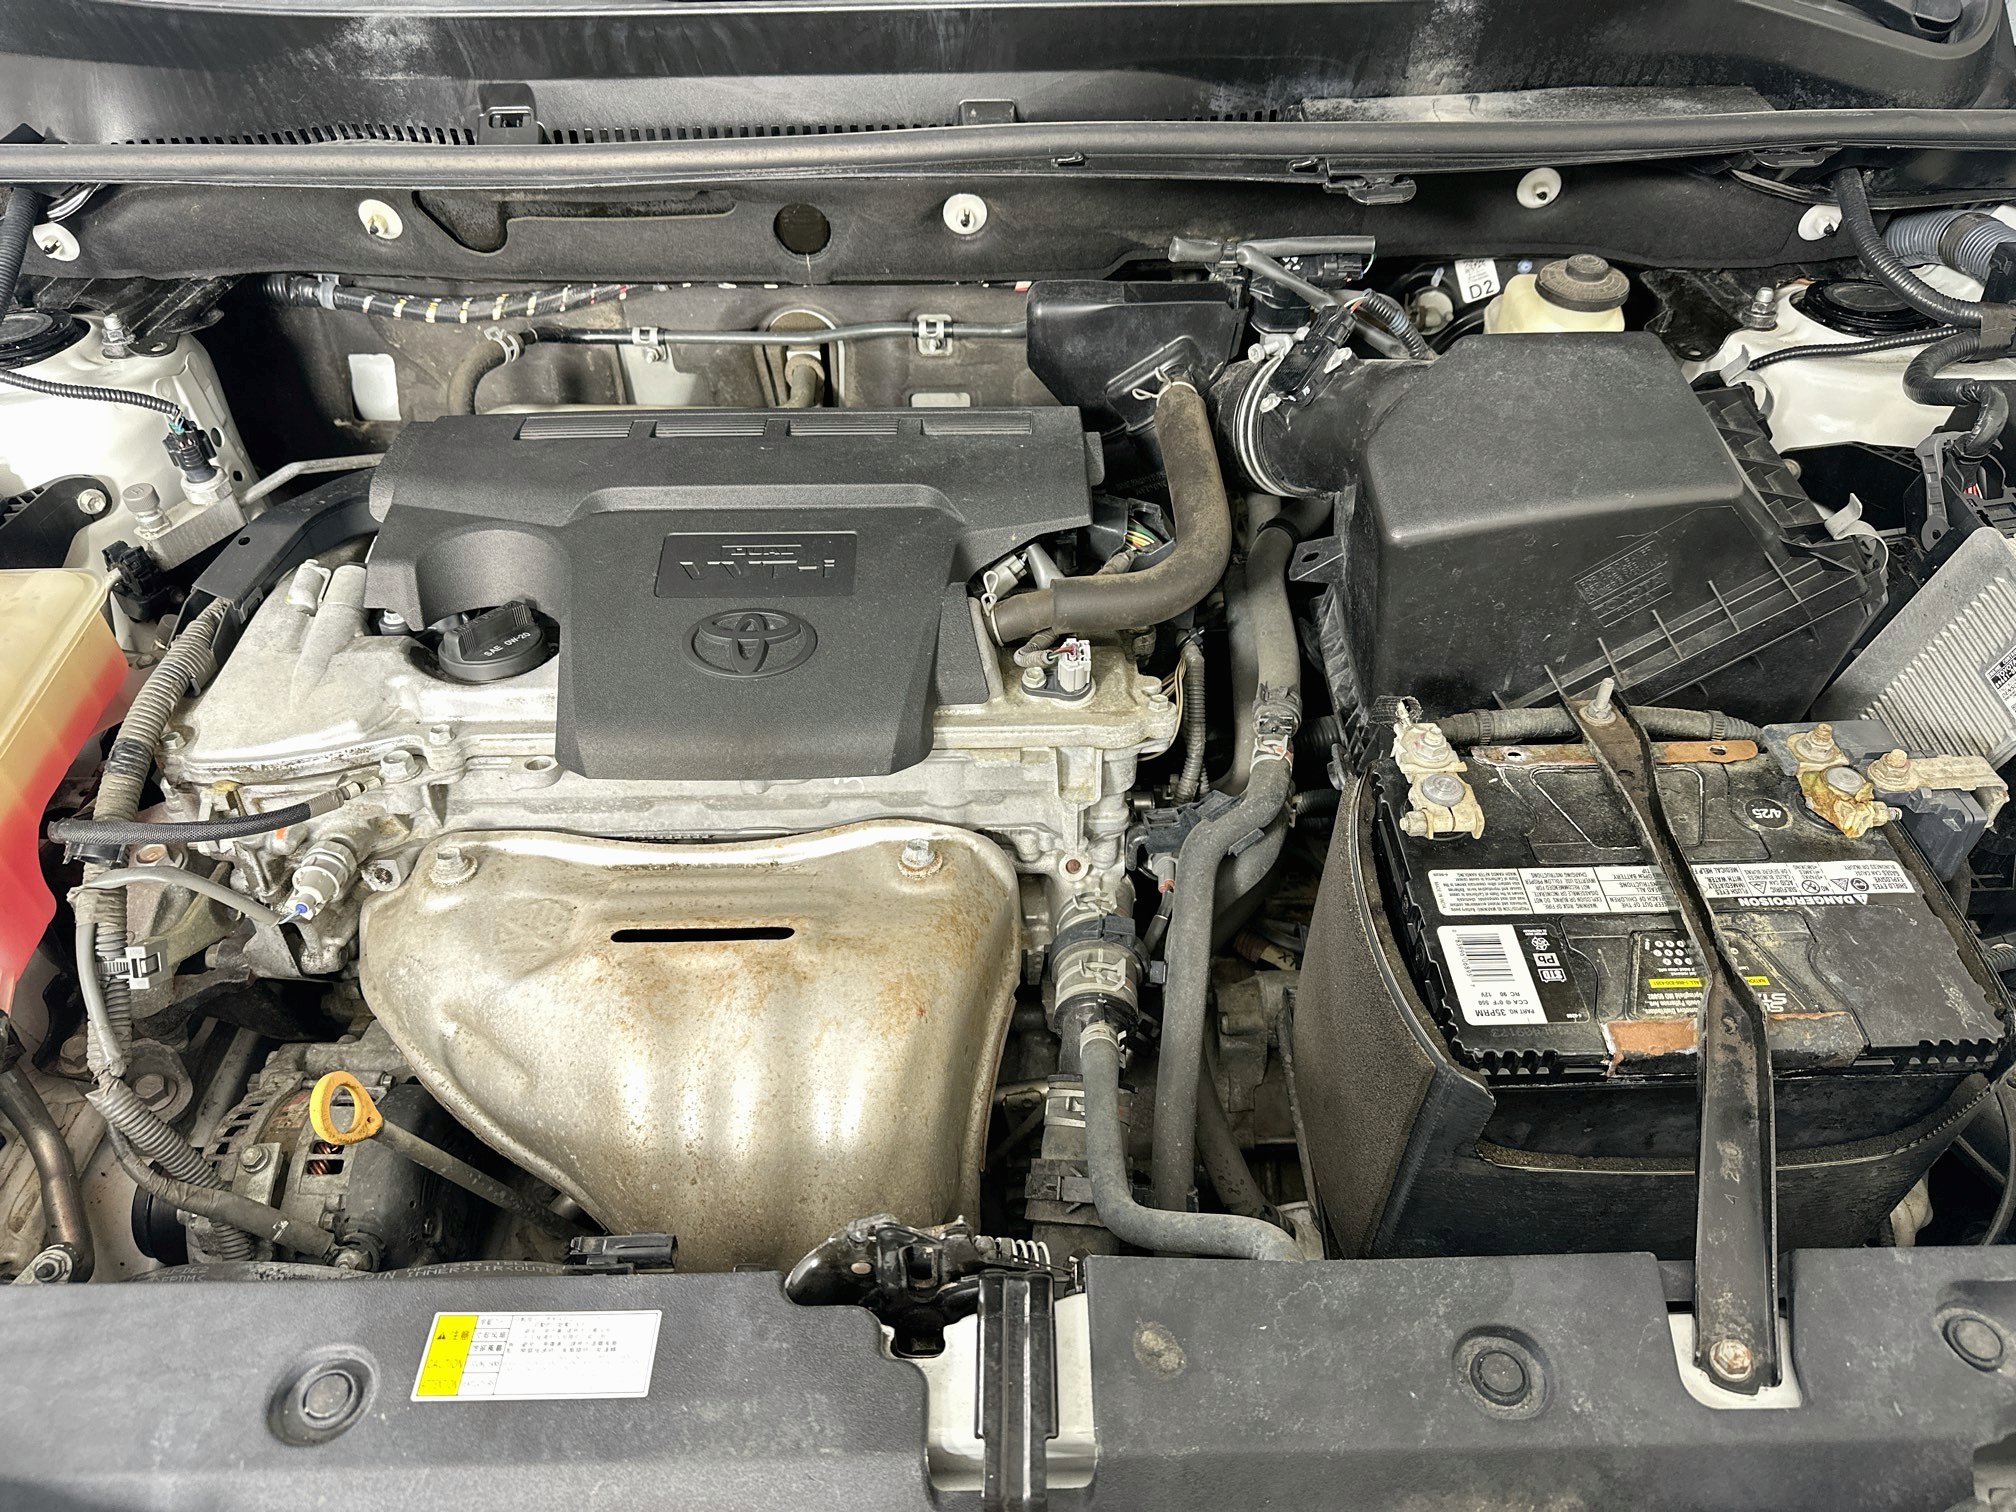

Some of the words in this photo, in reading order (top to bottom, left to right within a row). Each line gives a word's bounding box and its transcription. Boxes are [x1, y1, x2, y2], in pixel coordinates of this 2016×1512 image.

[1469, 279, 1495, 300] D2
[483, 644, 504, 657] SAE
[503, 631, 531, 646] 0W-20
[1751, 808, 1782, 819] 4/25
[1737, 894, 1855, 907] DANGER/POISON
[1537, 955, 1556, 964] Pb
[1474, 1008, 1507, 1017] 35PRM
